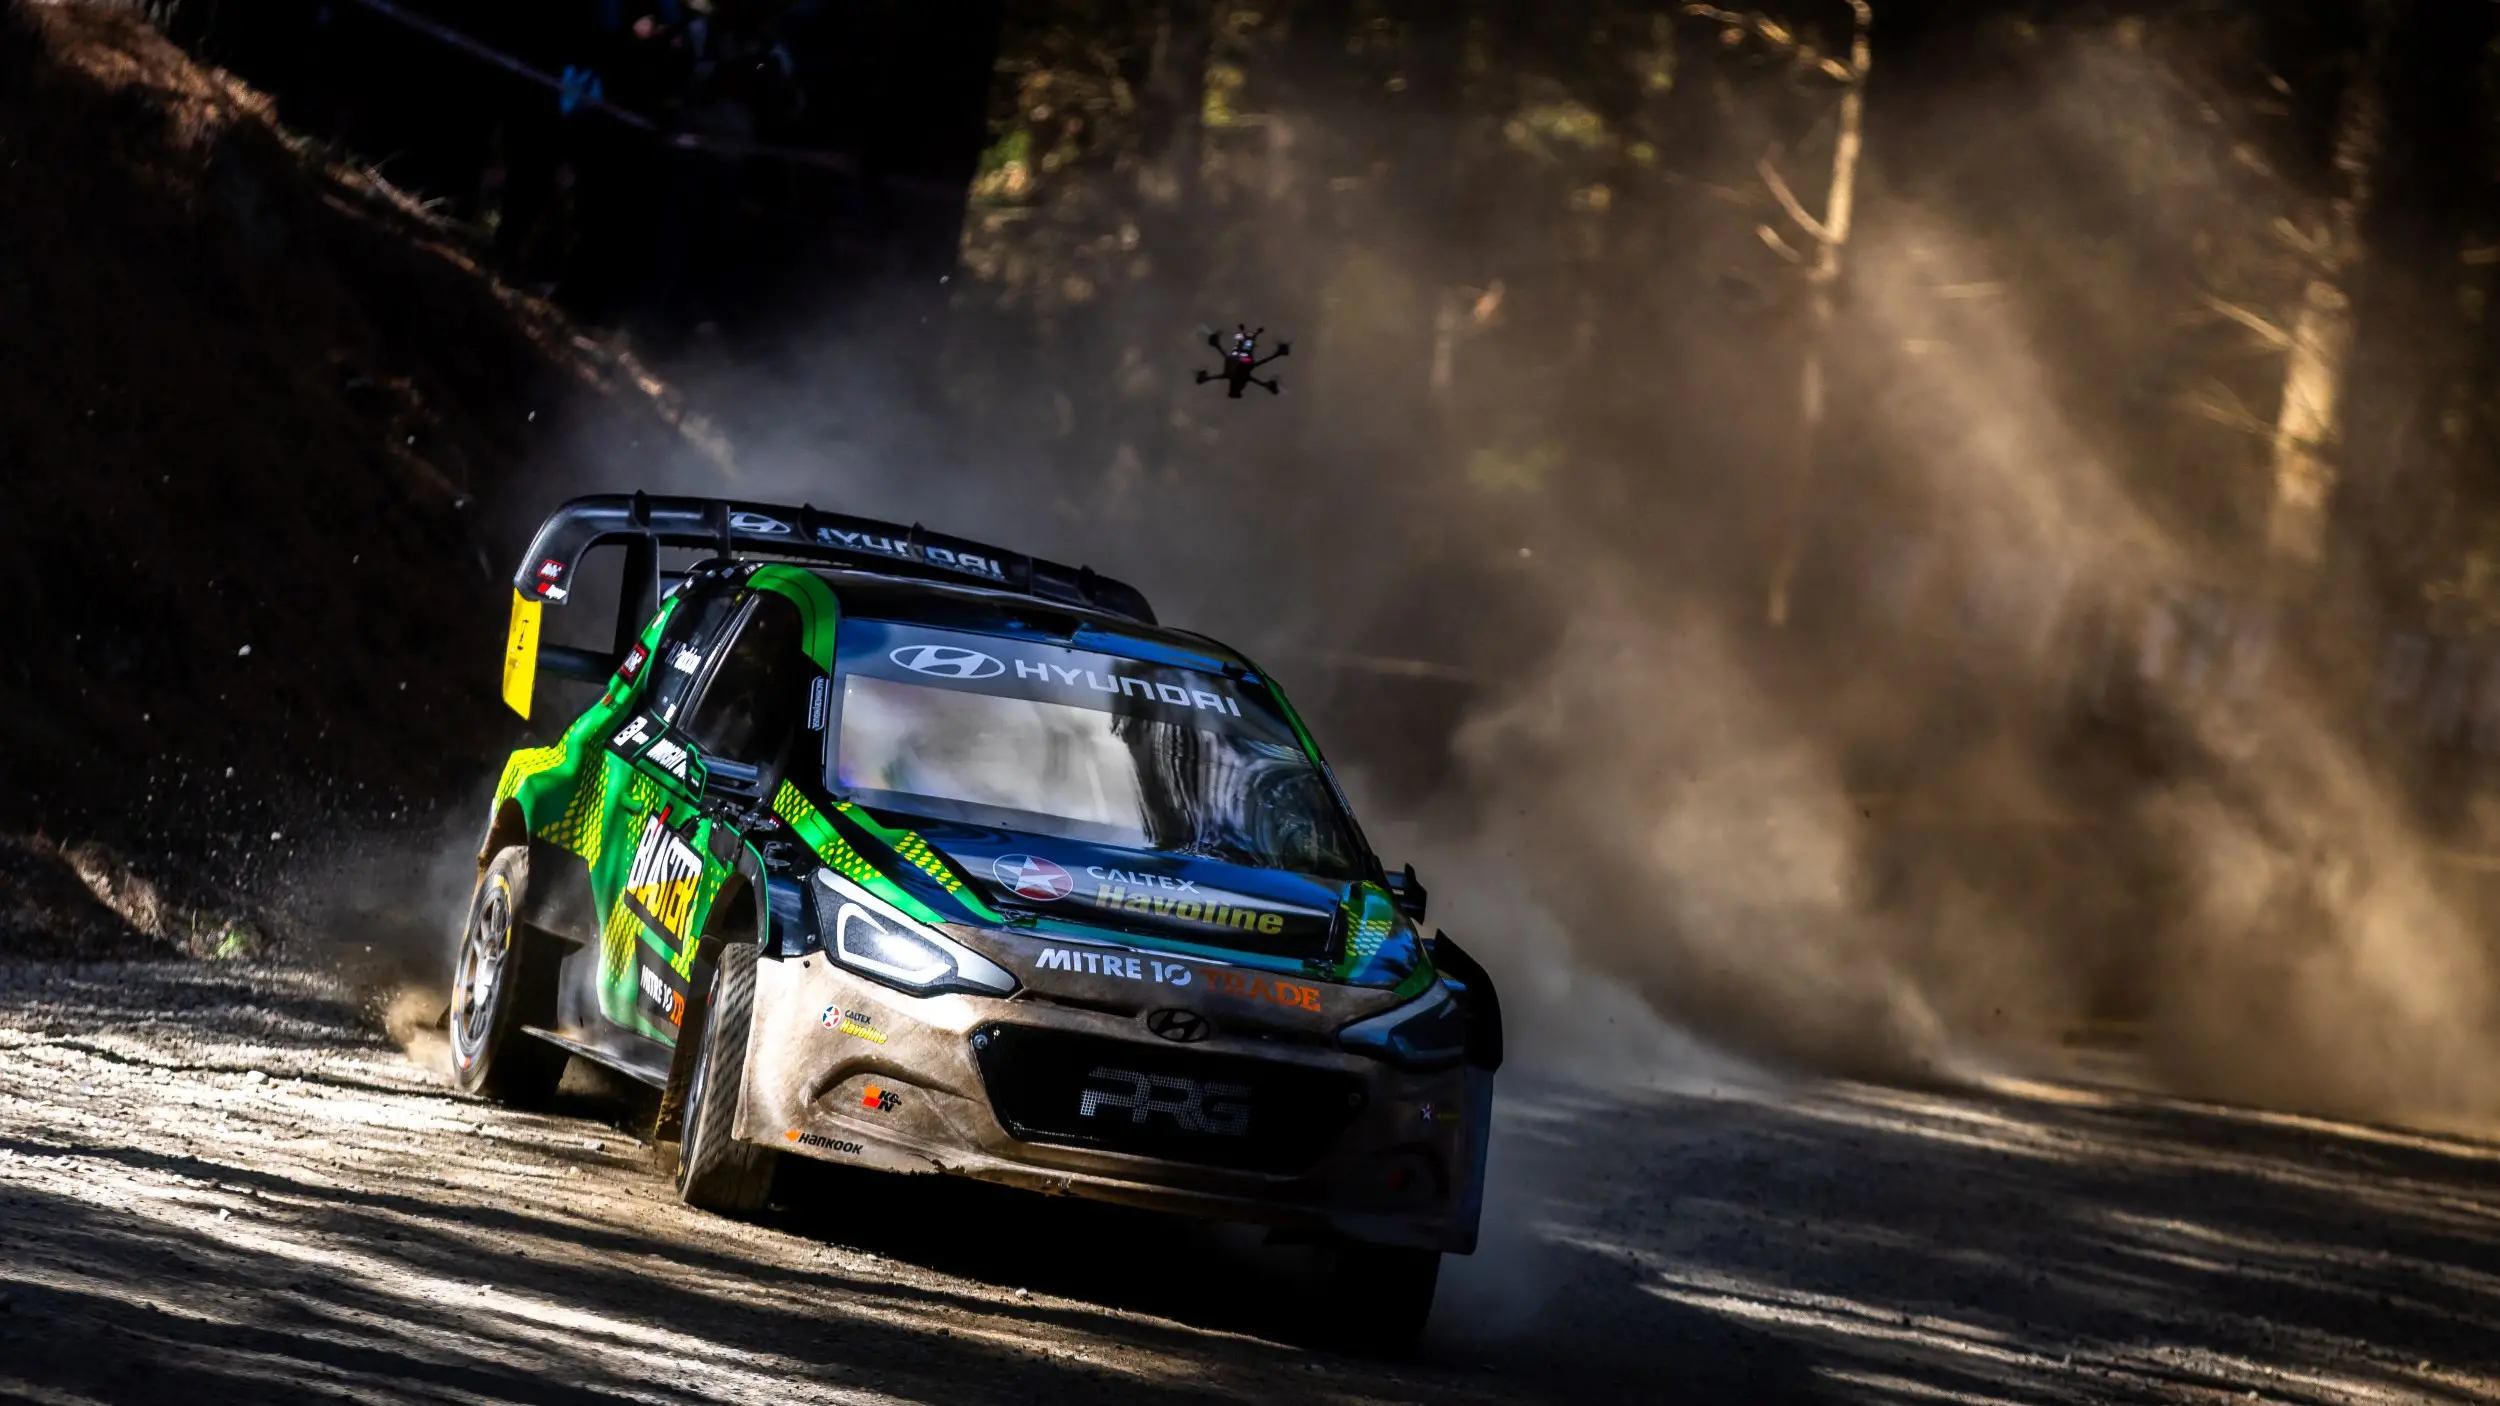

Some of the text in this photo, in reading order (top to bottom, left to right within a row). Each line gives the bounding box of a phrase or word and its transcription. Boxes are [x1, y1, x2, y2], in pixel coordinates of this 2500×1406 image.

[1014, 659, 1242, 718] HYUNDAI
[627, 813, 703, 941] BLASTER
[1086, 865, 1200, 894] CALTEX
[1096, 883, 1285, 935] Havoline
[1035, 948, 1192, 986] MITRE 10
[1201, 967, 1321, 1012] TRADE
[839, 1018, 889, 1045] Havoline
[844, 1009, 872, 1024] CALTEX
[1080, 1064, 1253, 1139] PRG
